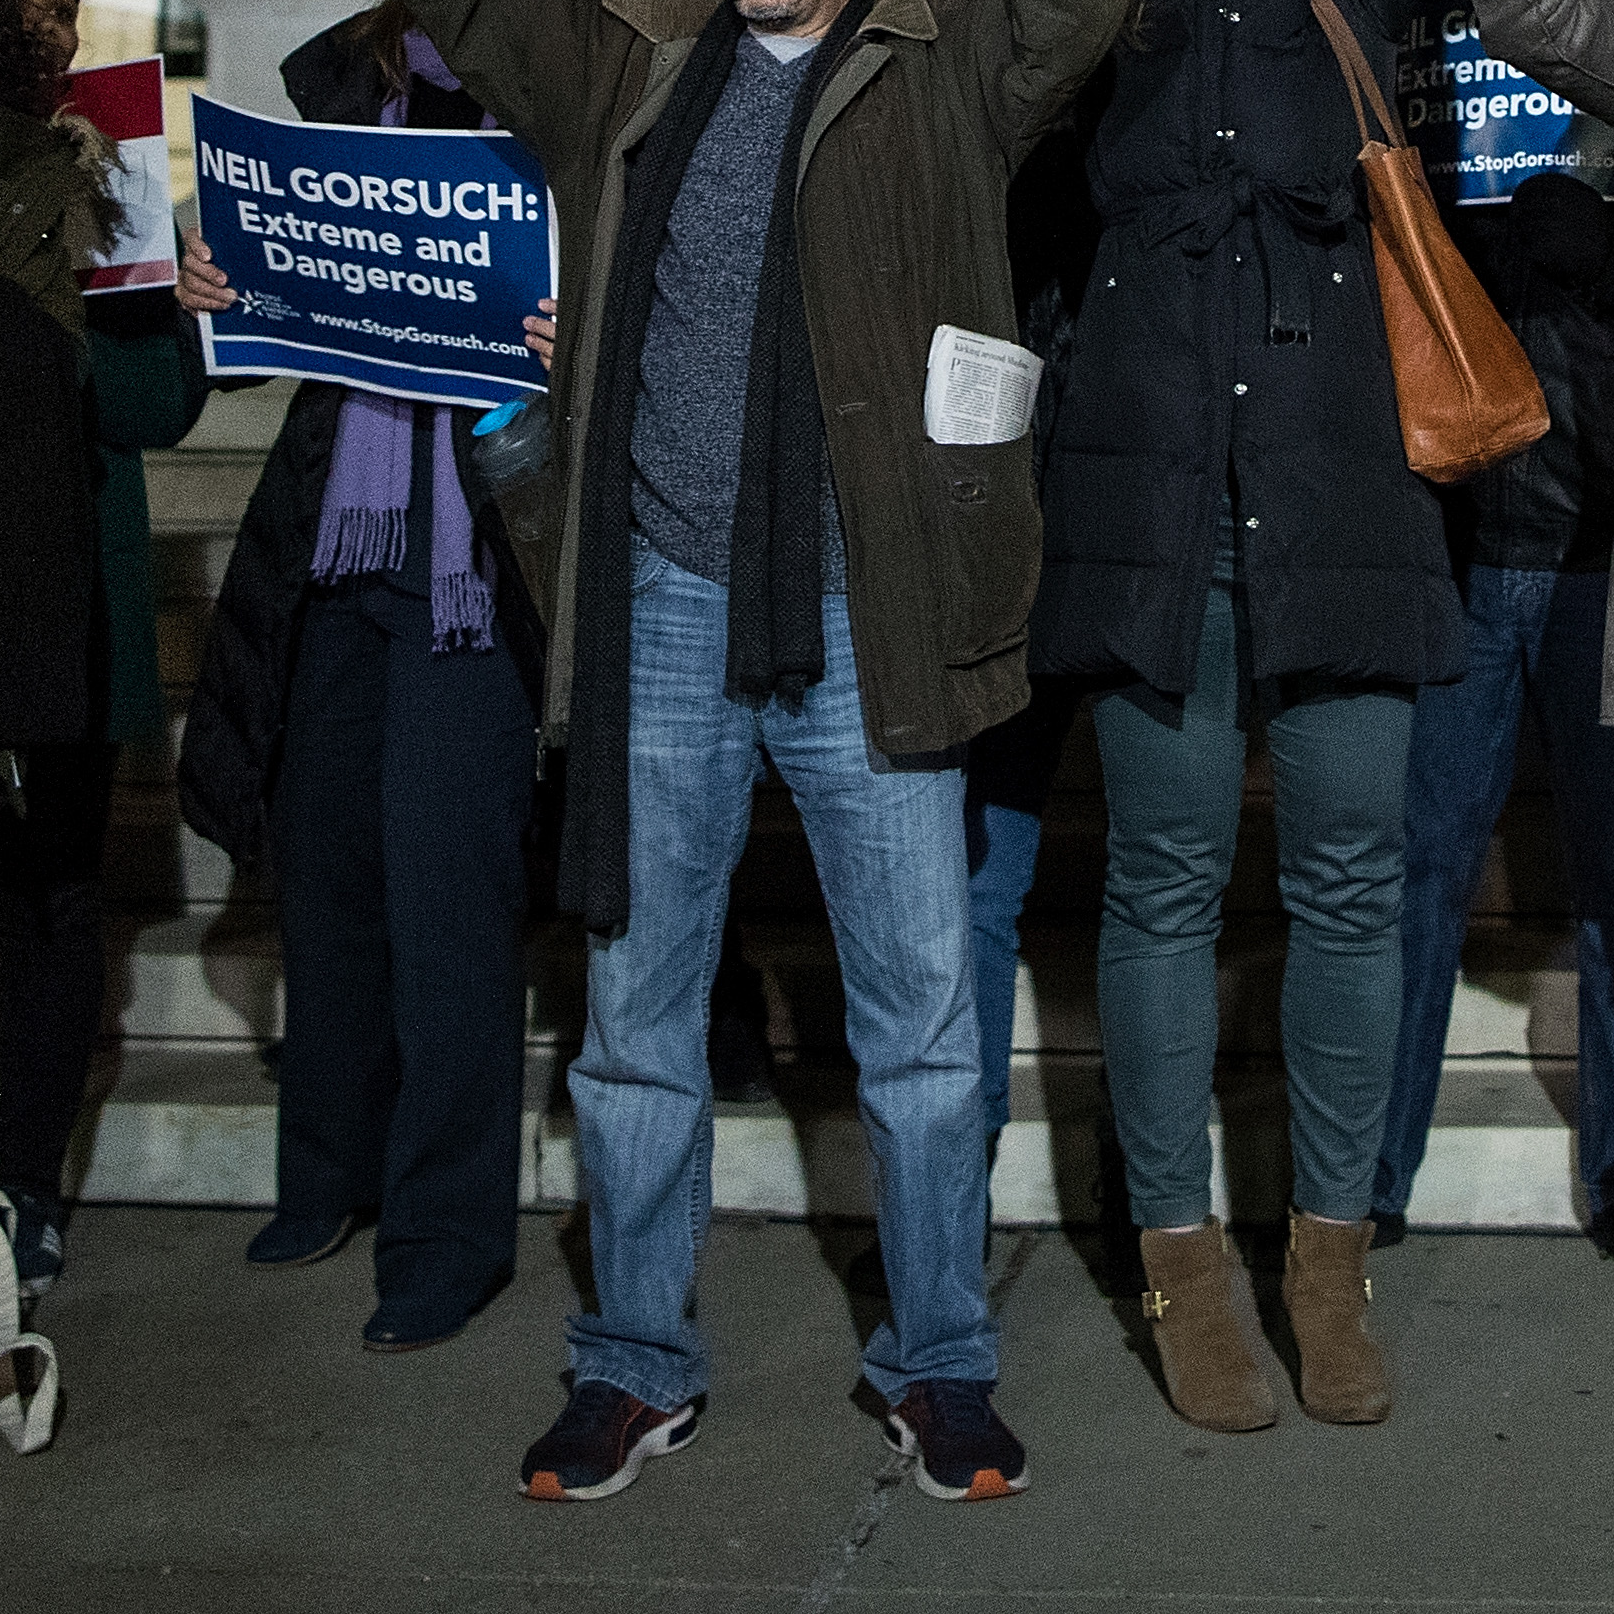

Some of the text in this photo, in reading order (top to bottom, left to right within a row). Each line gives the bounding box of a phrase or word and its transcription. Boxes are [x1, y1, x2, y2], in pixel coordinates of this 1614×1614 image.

[1407, 90, 1586, 131] Dangerou
[201, 141, 285, 198] NEIL
[290, 166, 539, 223] GORSUCH:
[237, 199, 492, 268] Extreme and
[262, 240, 478, 305] Dangerous
[310, 308, 530, 360] www.StopGorsuch.com
